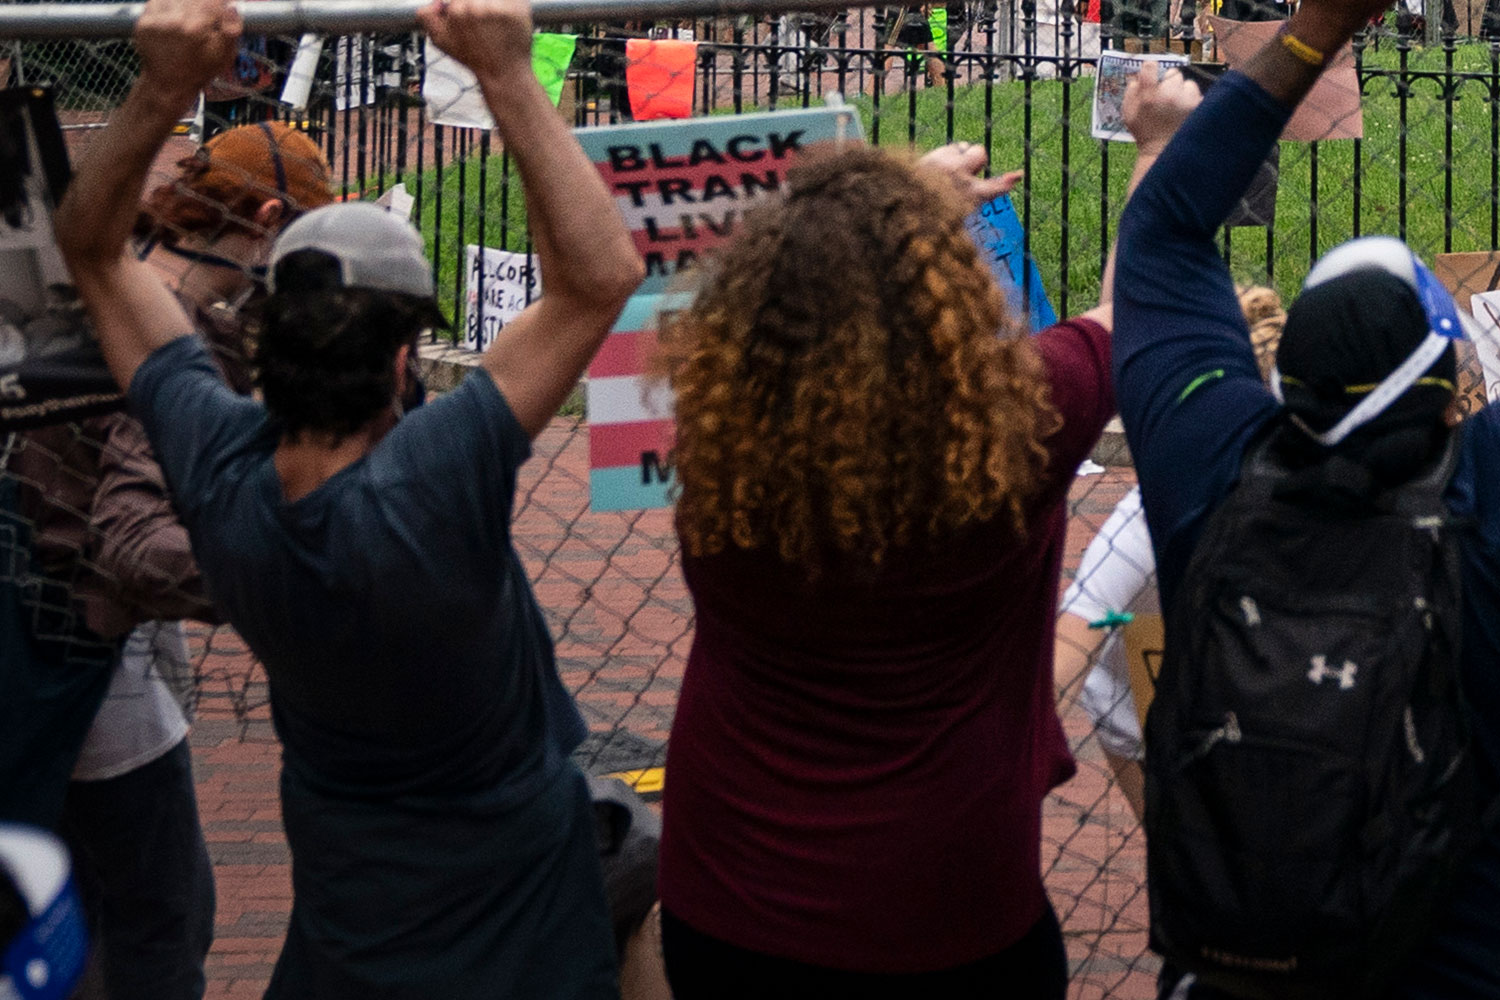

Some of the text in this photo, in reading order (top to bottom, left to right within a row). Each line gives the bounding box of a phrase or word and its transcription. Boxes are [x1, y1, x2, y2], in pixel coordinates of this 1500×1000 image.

[606, 129, 807, 173] BLACK
[613, 170, 781, 208] TRAN
[643, 210, 738, 242] LIV
